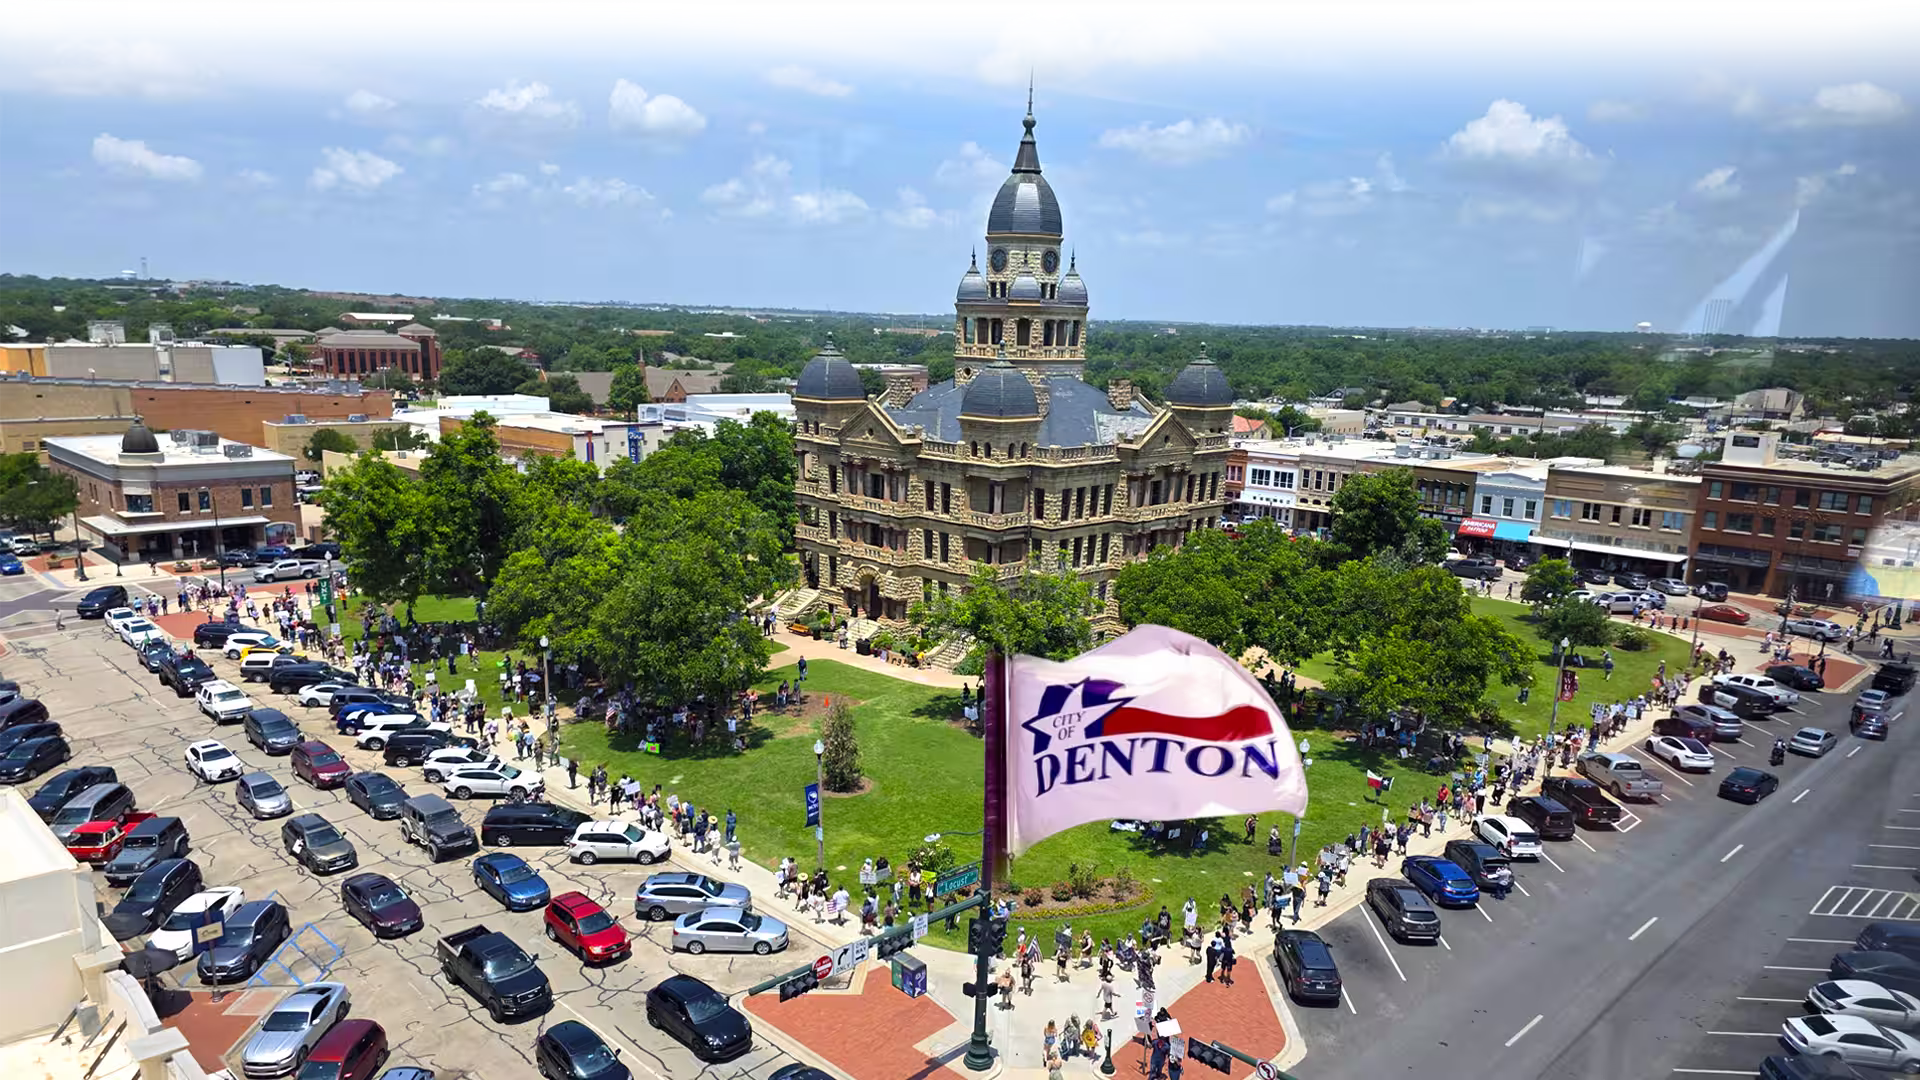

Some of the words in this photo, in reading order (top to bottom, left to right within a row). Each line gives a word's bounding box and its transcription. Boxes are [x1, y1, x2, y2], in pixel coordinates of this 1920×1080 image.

[1462, 519, 1495, 529] AMERICANA
[1052, 710, 1086, 728] CITY
[1057, 725, 1076, 740] OF
[1034, 737, 1281, 798] DENTON
[945, 875, 968, 891] Locust
